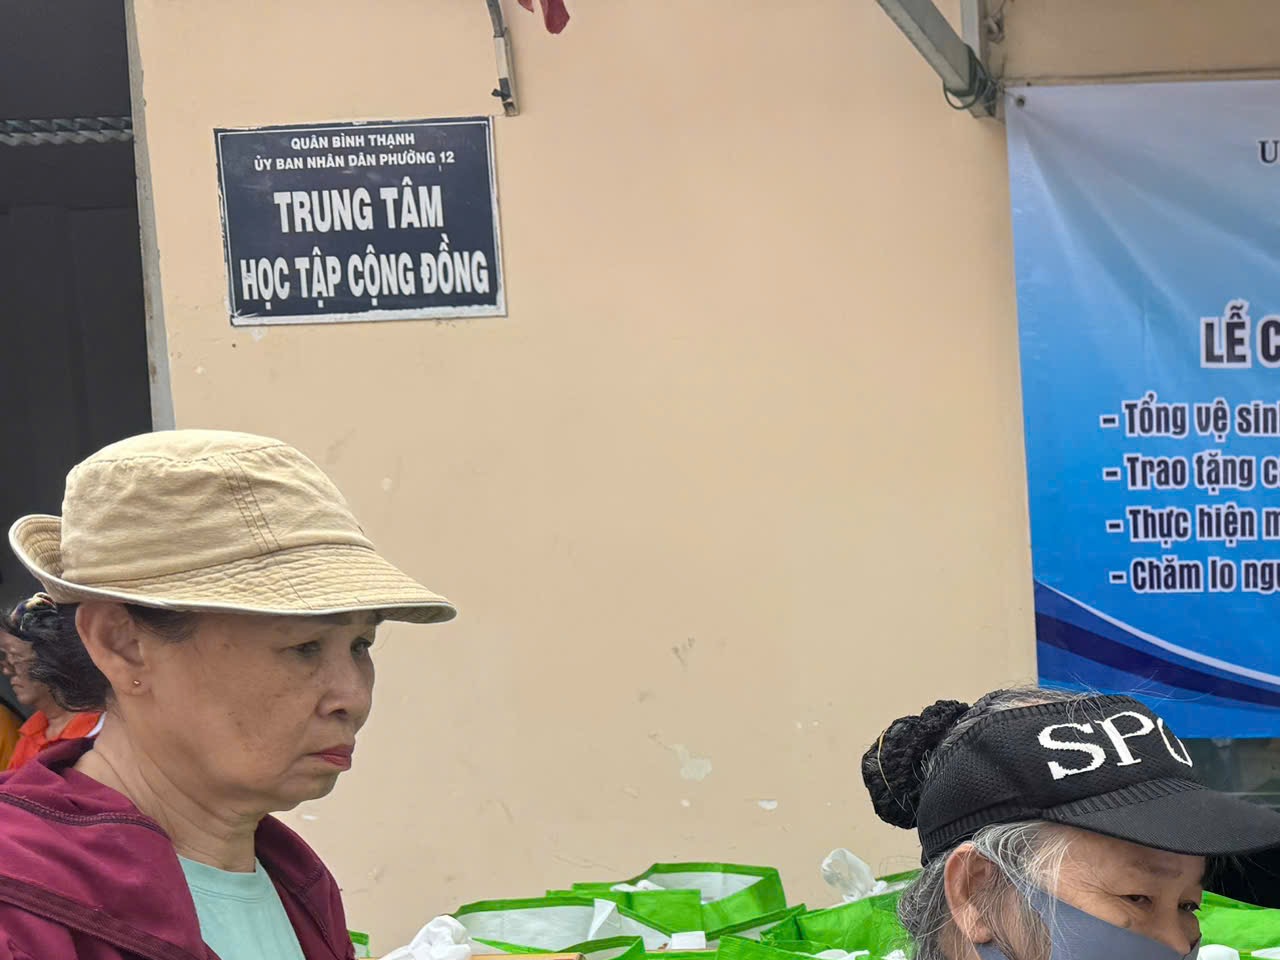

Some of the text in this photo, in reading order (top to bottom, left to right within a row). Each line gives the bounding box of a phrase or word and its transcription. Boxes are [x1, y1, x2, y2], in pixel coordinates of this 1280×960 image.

[254, 149, 455, 172] ỦY BAN NHÂN DÂN PHƯỜNG 12
[331, 132, 365, 148] BÌNH
[367, 132, 415, 149] THẠNH
[273, 176, 444, 233] TRUNG TÂM
[240, 233, 490, 310] HỌC TẬP CỘNG ĐỒNG
[1205, 305, 1247, 363] LỄ
[1124, 393, 1186, 435] Tổng
[1197, 400, 1227, 439] vệ
[1126, 456, 1186, 486] Trao
[1195, 455, 1253, 492] tặng
[1129, 509, 1188, 545] Thực
[1199, 505, 1254, 544] hiện
[1132, 558, 1200, 590] Chăm
[1211, 560, 1233, 589] lo
